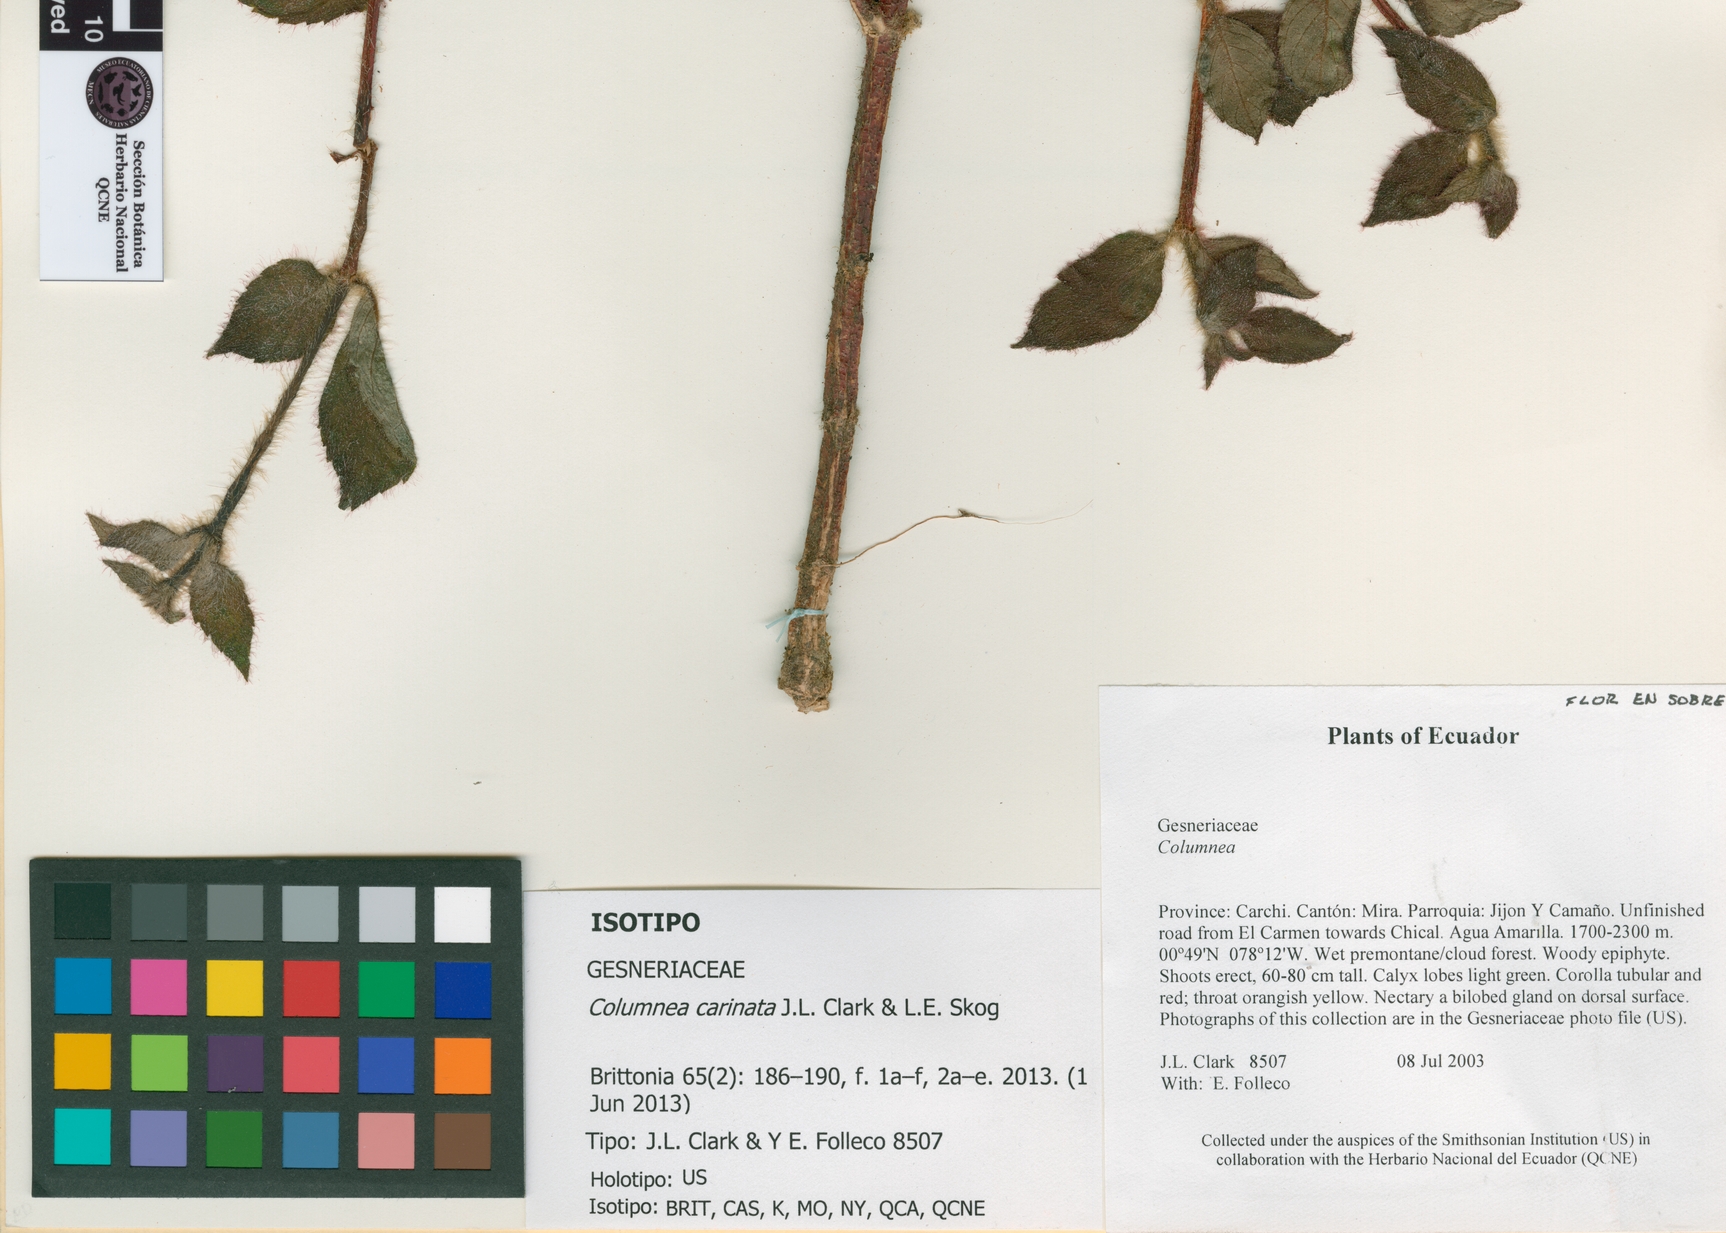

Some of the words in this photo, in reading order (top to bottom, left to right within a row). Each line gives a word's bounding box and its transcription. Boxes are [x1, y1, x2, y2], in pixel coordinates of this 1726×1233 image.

[84, 15, 104, 43] 10
[115, 133, 129, 203] Herbario
[132, 140, 146, 198] Sección
[95, 177, 110, 223] QCNE
[115, 206, 129, 273] Nacional
[132, 202, 146, 269] Botánica
[1565, 692, 1619, 707] FLOR
[1632, 692, 1657, 706] EN
[1667, 693, 1726, 707] SOBRE
[1327, 725, 1395, 746] Plants
[1400, 726, 1424, 746] of
[1428, 726, 1521, 746] Ecuador
[1157, 817, 1259, 833] Gesneriaceae
[1158, 839, 1236, 854] Columnea
[591, 911, 701, 933] ISOTIPO
[1158, 904, 1230, 919] Province:
[1236, 903, 1290, 919] Carchi.
[1296, 903, 1356, 919] Cantón:
[1362, 903, 1403, 918] Mira.
[1408, 903, 1485, 922] Parroquia:
[1489, 902, 1526, 922] Jijon
[1549, 903, 1615, 918] Camaño.
[1620, 902, 1705, 917] Unfinished
[1158, 925, 1192, 940] road
[1198, 925, 1234, 940] from
[1260, 925, 1320, 940] Carmen
[1325, 925, 1386, 940] towards
[1390, 924, 1444, 940] Chical.
[1449, 925, 1490, 943] Agua
[1493, 924, 1564, 939] Amarilla.
[1571, 924, 1650, 939] 1700-2300
[1655, 927, 1674, 940] m.
[1314, 946, 1345, 961] Wet
[1350, 946, 1486, 965] premontane/cloud
[1491, 945, 1537, 961] forest.
[1542, 945, 1595, 964] Woody
[1601, 945, 1670, 964] epiphyte.
[586, 959, 746, 979] GESNERIACEAE
[1159, 968, 1211, 983] Shoots
[1215, 970, 1257, 983] erect,
[1261, 968, 1306, 983] 60-80
[1311, 972, 1334, 983] cm
[1339, 967, 1367, 983] tall.
[1373, 967, 1418, 986] Calyx
[1424, 967, 1463, 982] lobes
[1468, 967, 1501, 986] light
[1505, 971, 1550, 986] green.
[1555, 967, 1612, 982] Corolla
[1616, 967, 1670, 982] tubular
[1674, 967, 1702, 982] and
[1159, 990, 1189, 1005] red;
[1193, 990, 1238, 1005] throat
[1242, 989, 1308, 1008] orangish
[1312, 989, 1367, 1008] yellow.
[1374, 989, 1433, 1008] Nectary
[1452, 989, 1508, 1004] bilobed
[1512, 989, 1553, 1008] gland
[1581, 989, 1626, 1004] dorsal
[1631, 988, 1689, 1004] surface.
[589, 997, 690, 1017] Columnea
[696, 997, 777, 1017] carinata
[780, 997, 816, 1017] J.L.
[823, 997, 875, 1017] Clark
[904, 997, 942, 1017] L.E.
[950, 997, 999, 1021] Skog
[1160, 1011, 1255, 1030] Photographs
[1258, 1011, 1277, 1026] of
[1279, 1011, 1308, 1026] this
[1311, 1011, 1387, 1026] collection
[1392, 1014, 1415, 1026] are
[1439, 1010, 1463, 1026] the
[1467, 1010, 1565, 1025] Gesneriaceae
[1569, 1010, 1613, 1029] photo
[1618, 1010, 1642, 1025] file
[1646, 1010, 1687, 1027] (US).
[1160, 1054, 1188, 1069] J.L.
[1193, 1054, 1235, 1069] Clark
[1249, 1054, 1287, 1069] 8507
[1396, 1053, 1416, 1068] 08
[1420, 1053, 1442, 1068] Jul
[1447, 1053, 1484, 1068] 2003
[590, 1066, 674, 1086] Brittonia
[682, 1066, 743, 1091] 65(2):
[1002, 1066, 1058, 1086] 2013.
[1161, 1076, 1203, 1091] With:
[1212, 1075, 1229, 1091] E.
[1234, 1075, 1291, 1090] Folleco
[589, 1094, 625, 1113] Jun
[632, 1093, 691, 1115] 2013)
[584, 1131, 636, 1155] Tipo:
[645, 1131, 681, 1151] J.L.
[688, 1131, 740, 1151] Clark
[789, 1131, 808, 1150] E.
[816, 1131, 886, 1151] Folleco
[893, 1131, 943, 1151] 8507
[1201, 1133, 1266, 1147] Collected
[1270, 1133, 1309, 1147] under
[1312, 1133, 1333, 1147] the
[1337, 1136, 1395, 1150] auspices
[1398, 1132, 1416, 1147] of
[1417, 1132, 1438, 1147] the
[1441, 1132, 1526, 1147] Smithsonian
[1529, 1131, 1599, 1147] Institution
[1216, 1152, 1305, 1166] collaboration
[1309, 1152, 1339, 1166] with
[1343, 1152, 1364, 1166] the
[1368, 1152, 1428, 1166] Herbario
[1432, 1152, 1493, 1166] Nacional
[1497, 1152, 1517, 1165] del
[1521, 1151, 1578, 1166] Ecuador
[591, 1170, 672, 1192] Holotipo:
[682, 1168, 708, 1186] US
[589, 1197, 658, 1219] Isotipo:
[666, 1199, 716, 1220] BRIT,
[723, 1199, 765, 1220] CAS,
[772, 1199, 790, 1221] K,
[797, 1199, 833, 1221] MO,
[841, 1199, 872, 1221] NY,
[879, 1199, 925, 1221] QCA,
[932, 1199, 986, 1221] QCNE
